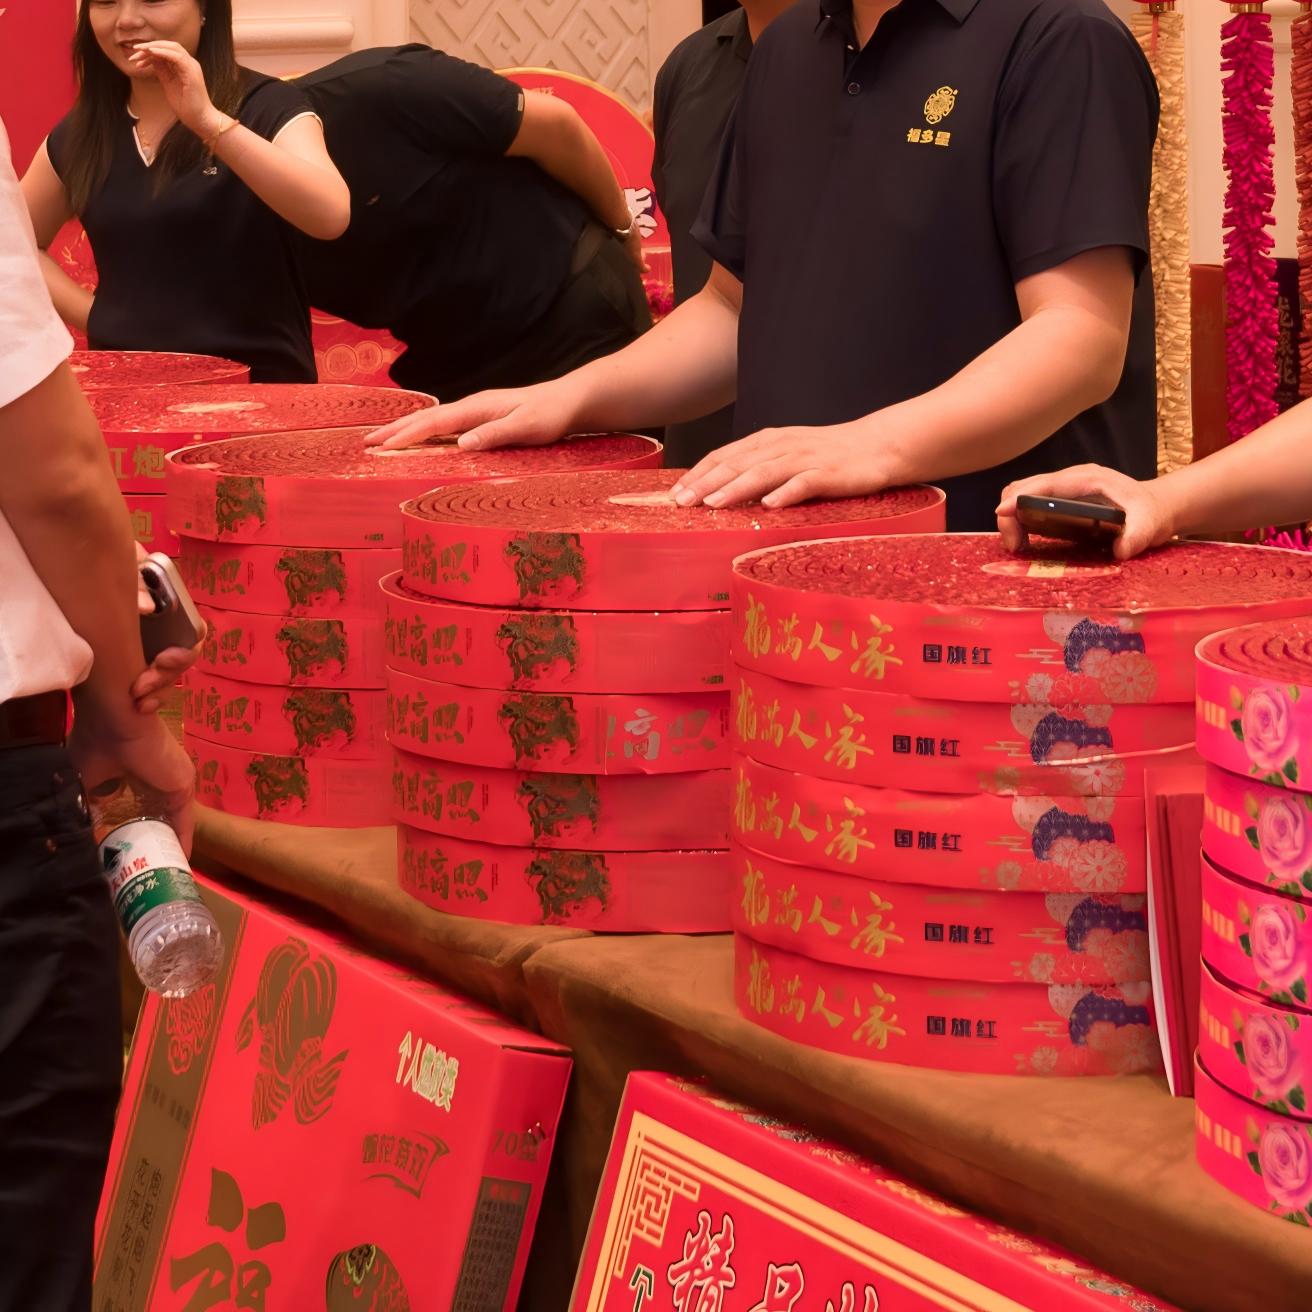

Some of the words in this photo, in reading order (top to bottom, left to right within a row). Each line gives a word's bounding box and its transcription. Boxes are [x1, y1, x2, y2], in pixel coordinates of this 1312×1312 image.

[922, 643, 993, 666] 国旗红
[892, 734, 961, 758] 国旗红
[893, 828, 963, 853] 国旗红
[923, 921, 995, 946] 国旗红
[926, 1015, 998, 1040] 国旗红
